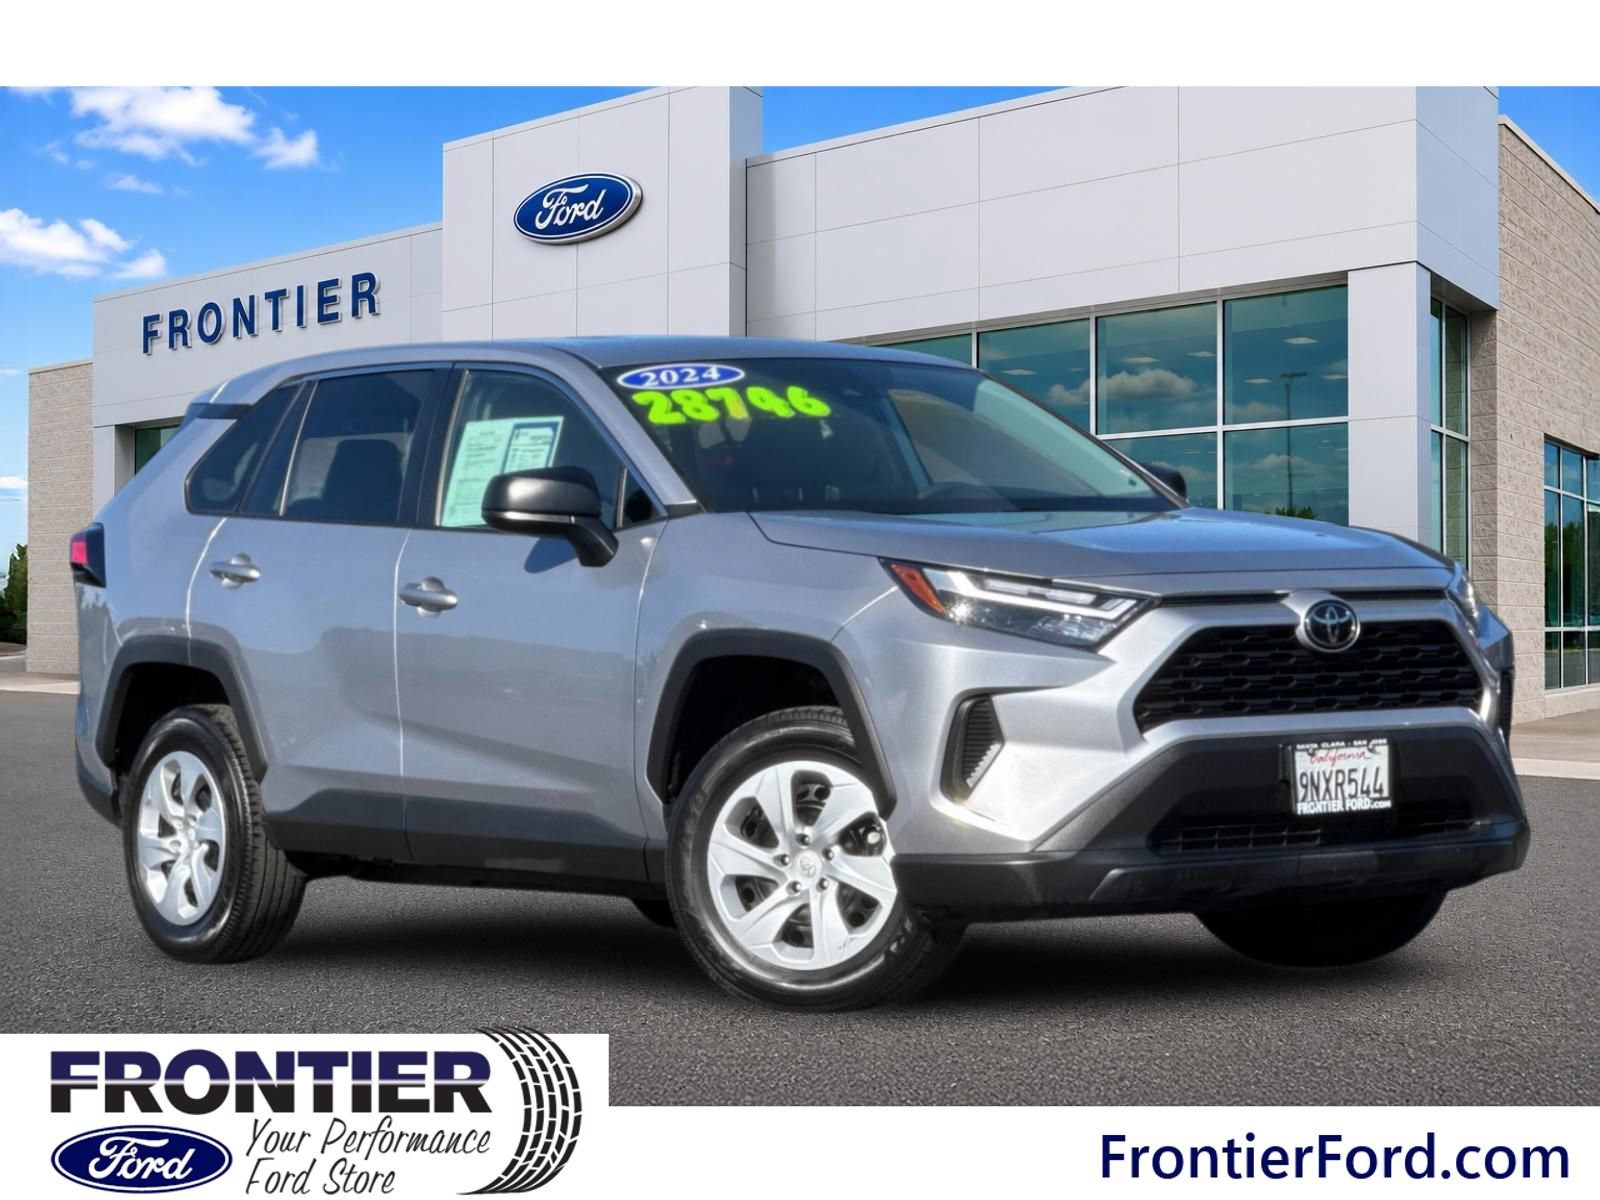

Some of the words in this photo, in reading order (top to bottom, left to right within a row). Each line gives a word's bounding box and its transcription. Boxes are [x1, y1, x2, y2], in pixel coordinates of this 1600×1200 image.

[535, 183, 607, 230] Ford
[143, 272, 380, 355] FRONTIER
[640, 366, 721, 387] 2024
[1300, 766, 1384, 803] 9NXR544
[1297, 800, 1344, 815] FRONTIER
